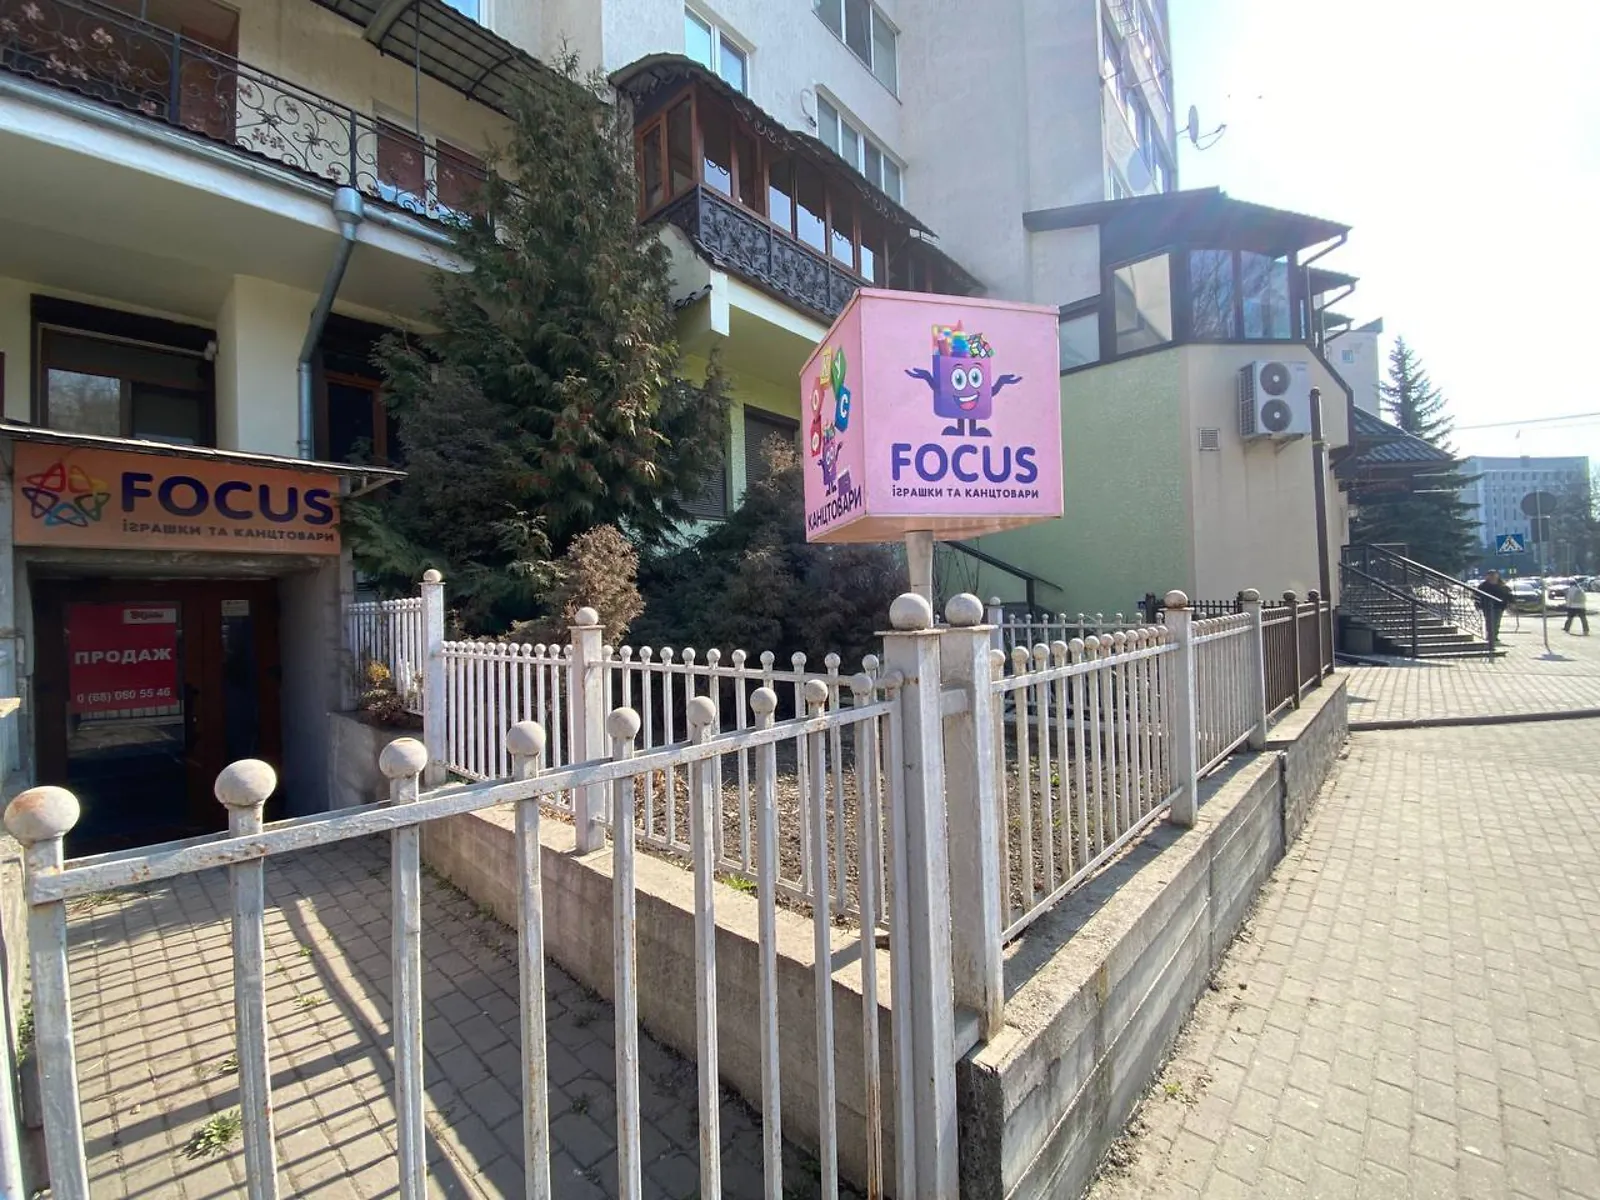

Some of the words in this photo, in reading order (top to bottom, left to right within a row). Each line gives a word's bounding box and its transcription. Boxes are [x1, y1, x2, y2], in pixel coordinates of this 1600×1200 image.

[892, 443, 1038, 484] FOCUS
[121, 471, 335, 525] FOCUS
[807, 484, 862, 532] КАНЦТОВАРИ
[947, 487, 962, 498] ТА
[965, 487, 1039, 500] КАНЦТОВАРИ
[208, 526, 229, 537] ТА
[234, 528, 334, 542] КАНЦТОВАРИ
[75, 648, 172, 665] ПРОДАЖ
